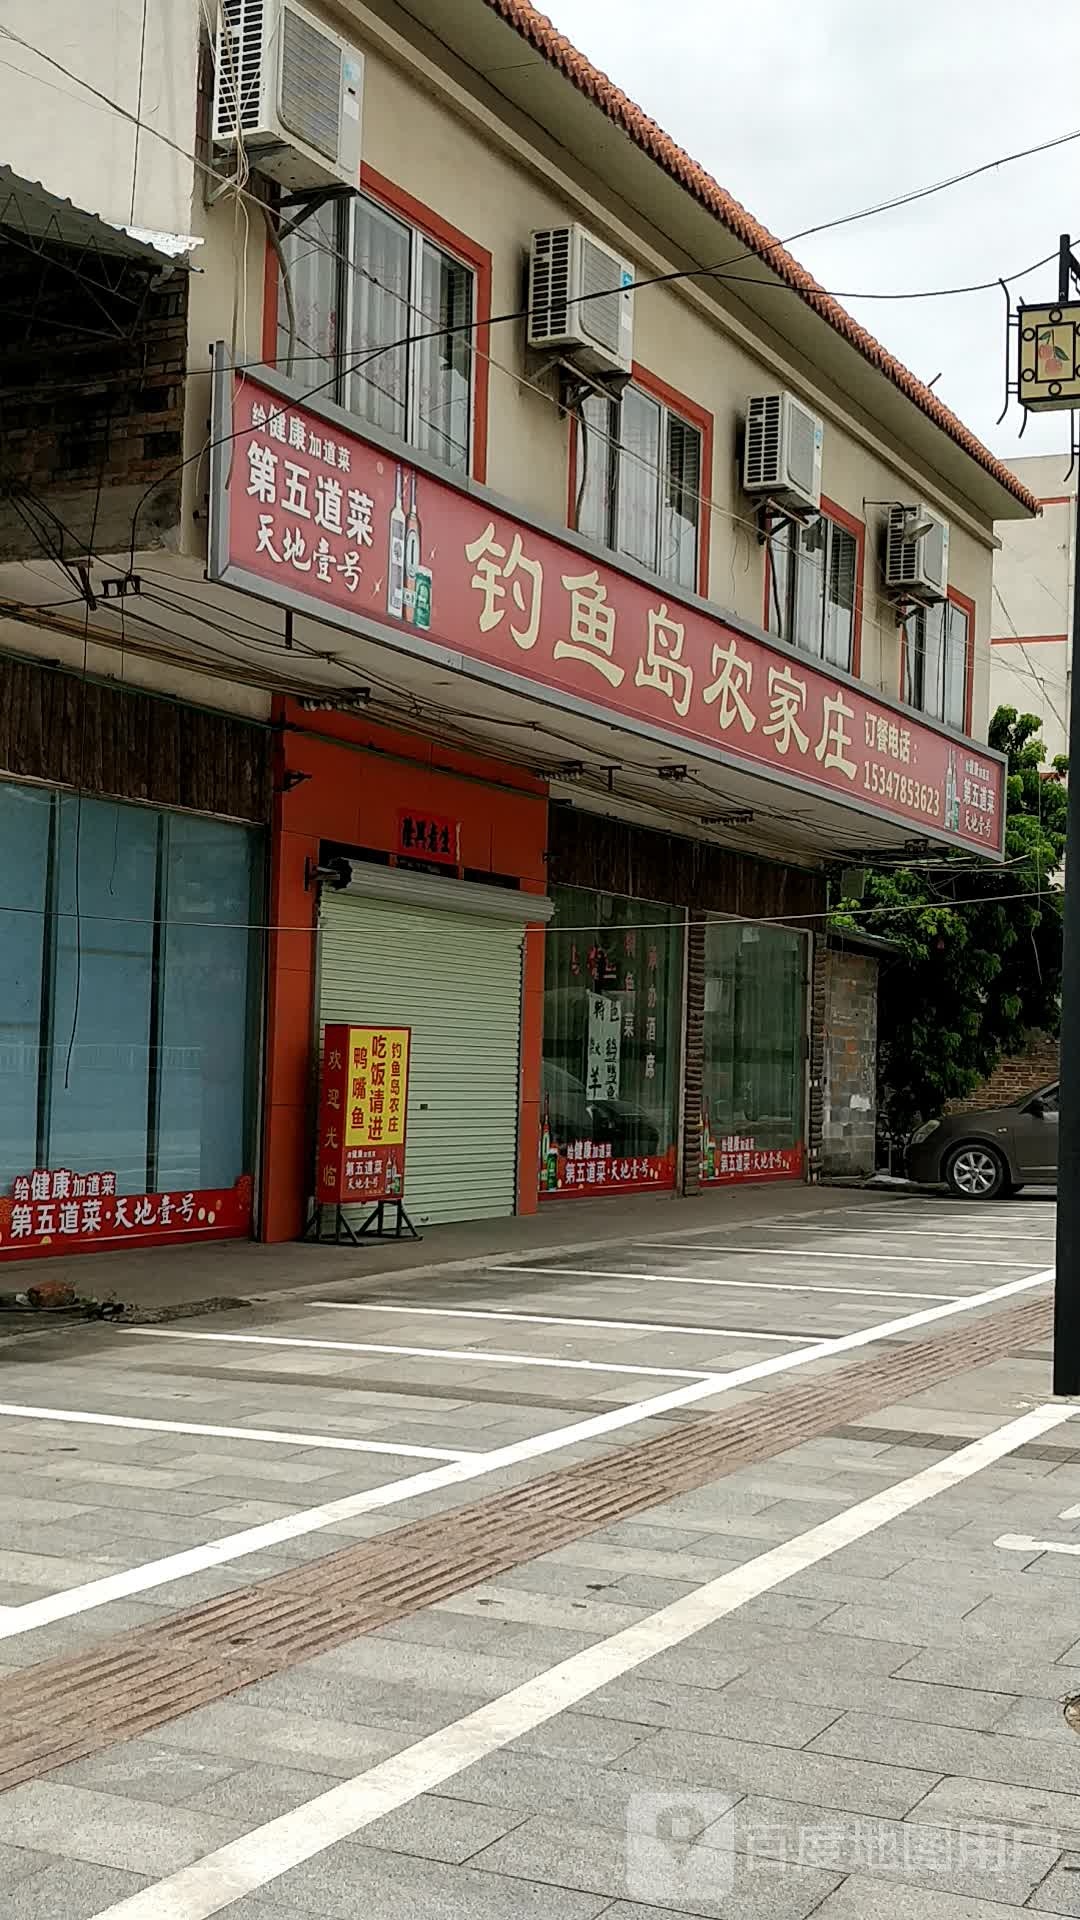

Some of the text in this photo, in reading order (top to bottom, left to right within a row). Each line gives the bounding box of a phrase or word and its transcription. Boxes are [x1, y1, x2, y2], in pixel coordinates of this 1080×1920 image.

[251, 402, 351, 473] 给健康加道菜
[246, 440, 375, 547] 第五道菜
[256, 513, 363, 592] 天地壹号
[465, 521, 859, 781] 钓鱼岛农家庄
[863, 760, 941, 817] 15347853623
[963, 778, 996, 815] 第五道菜
[322, 1049, 342, 1188] 欢迎光临
[350, 1046, 368, 1130] 鸭嘴鱼
[368, 1034, 387, 1141] 吃饭请进
[387, 1042, 402, 1133] 钓鱼岛农庄
[13, 1168, 117, 1201] 给健康加道菜
[345, 1158, 383, 1176] 第五道菜
